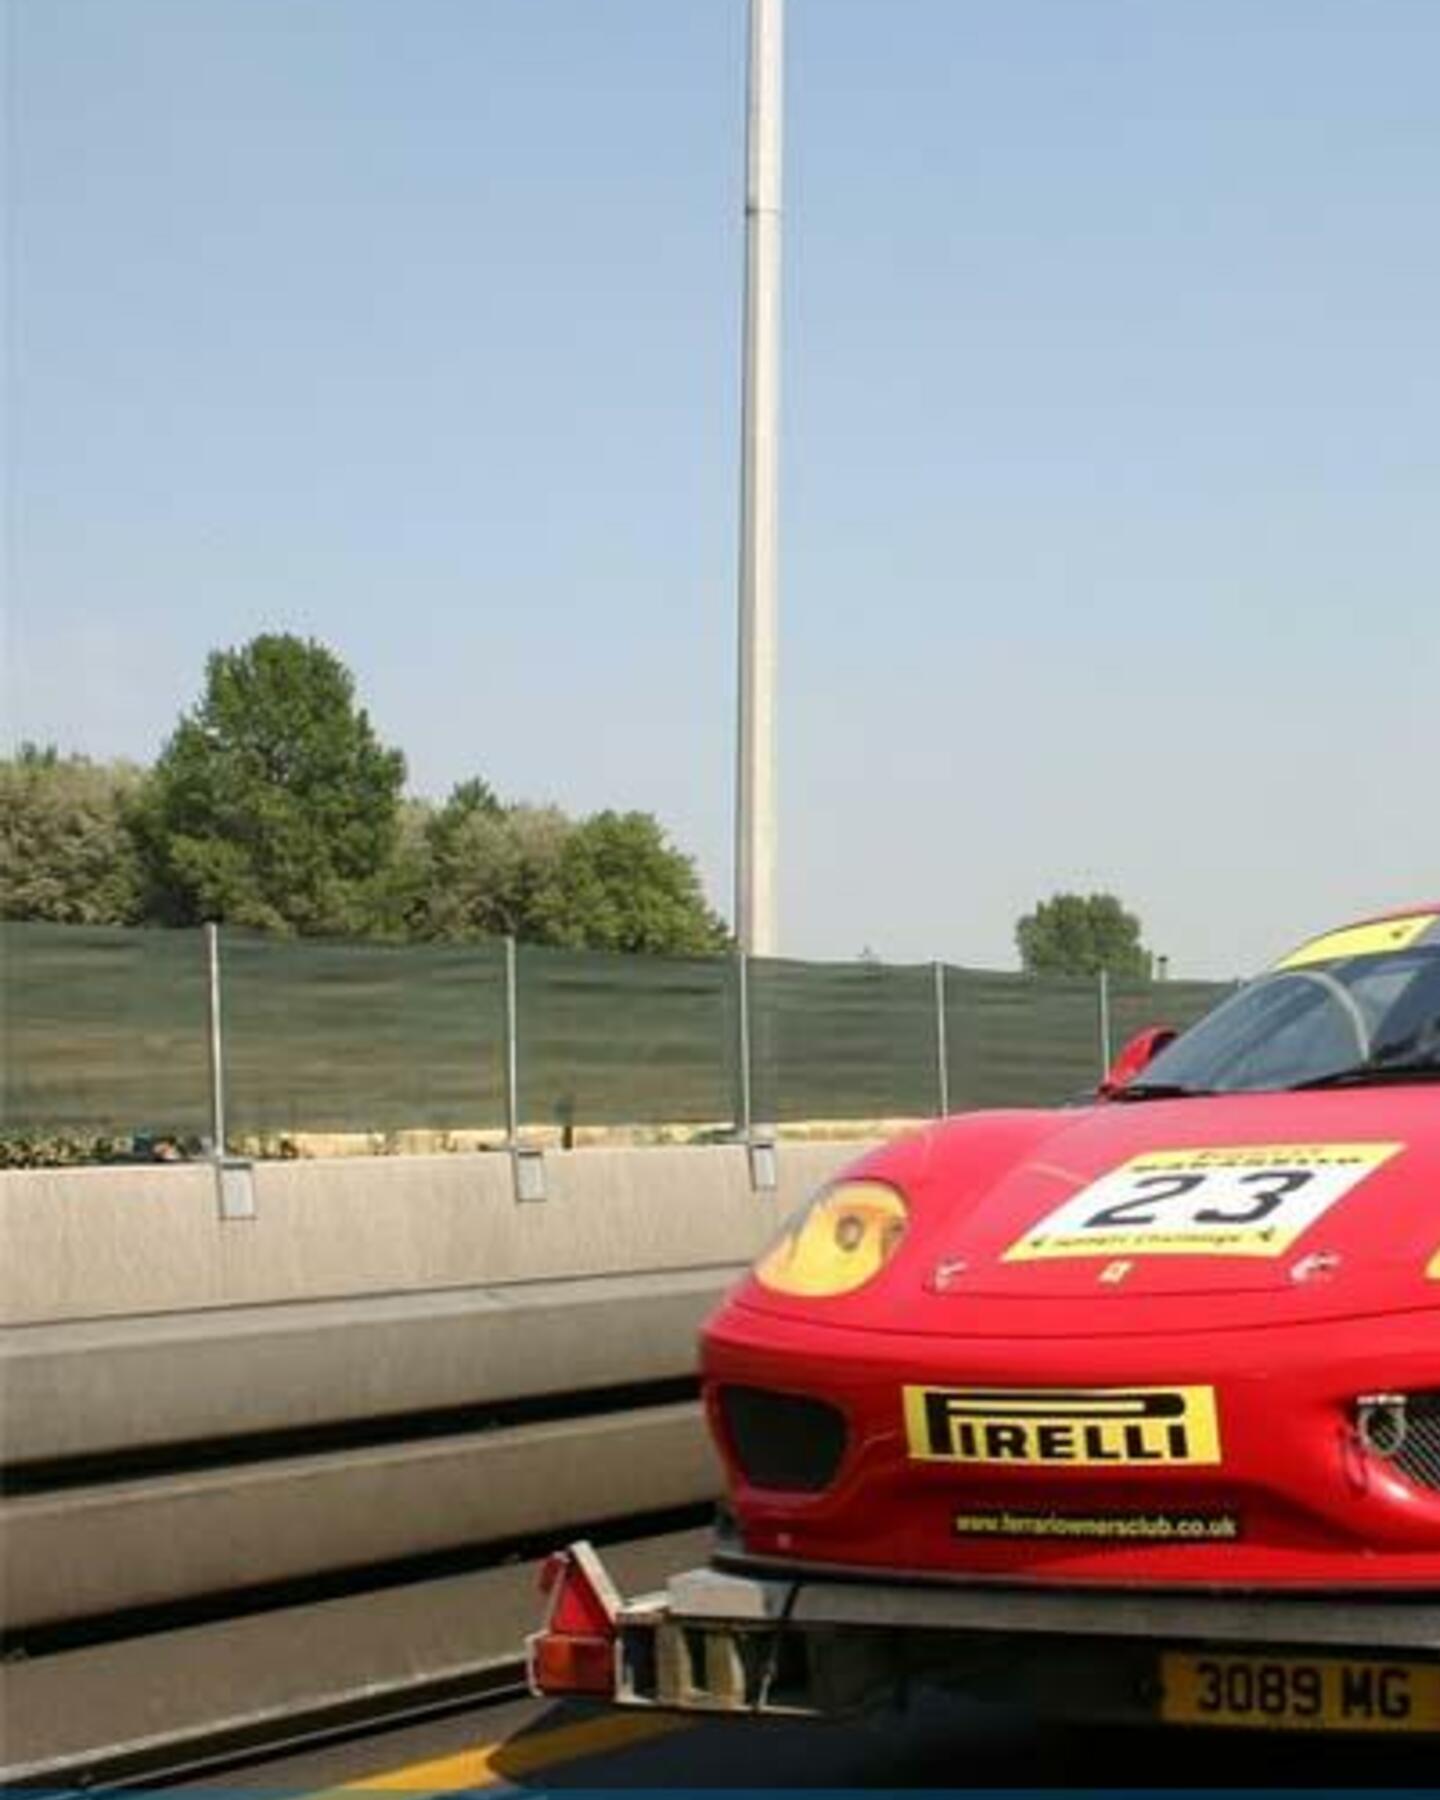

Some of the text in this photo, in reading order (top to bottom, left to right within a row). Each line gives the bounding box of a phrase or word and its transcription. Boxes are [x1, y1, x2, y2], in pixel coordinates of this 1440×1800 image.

[1081, 1169, 1314, 1229] 23
[924, 1392, 1189, 1459] PIRELLI
[956, 1512, 1237, 1538] www.ferrariownersclub.co.uk
[1196, 1661, 1411, 1719] 3089 MG
